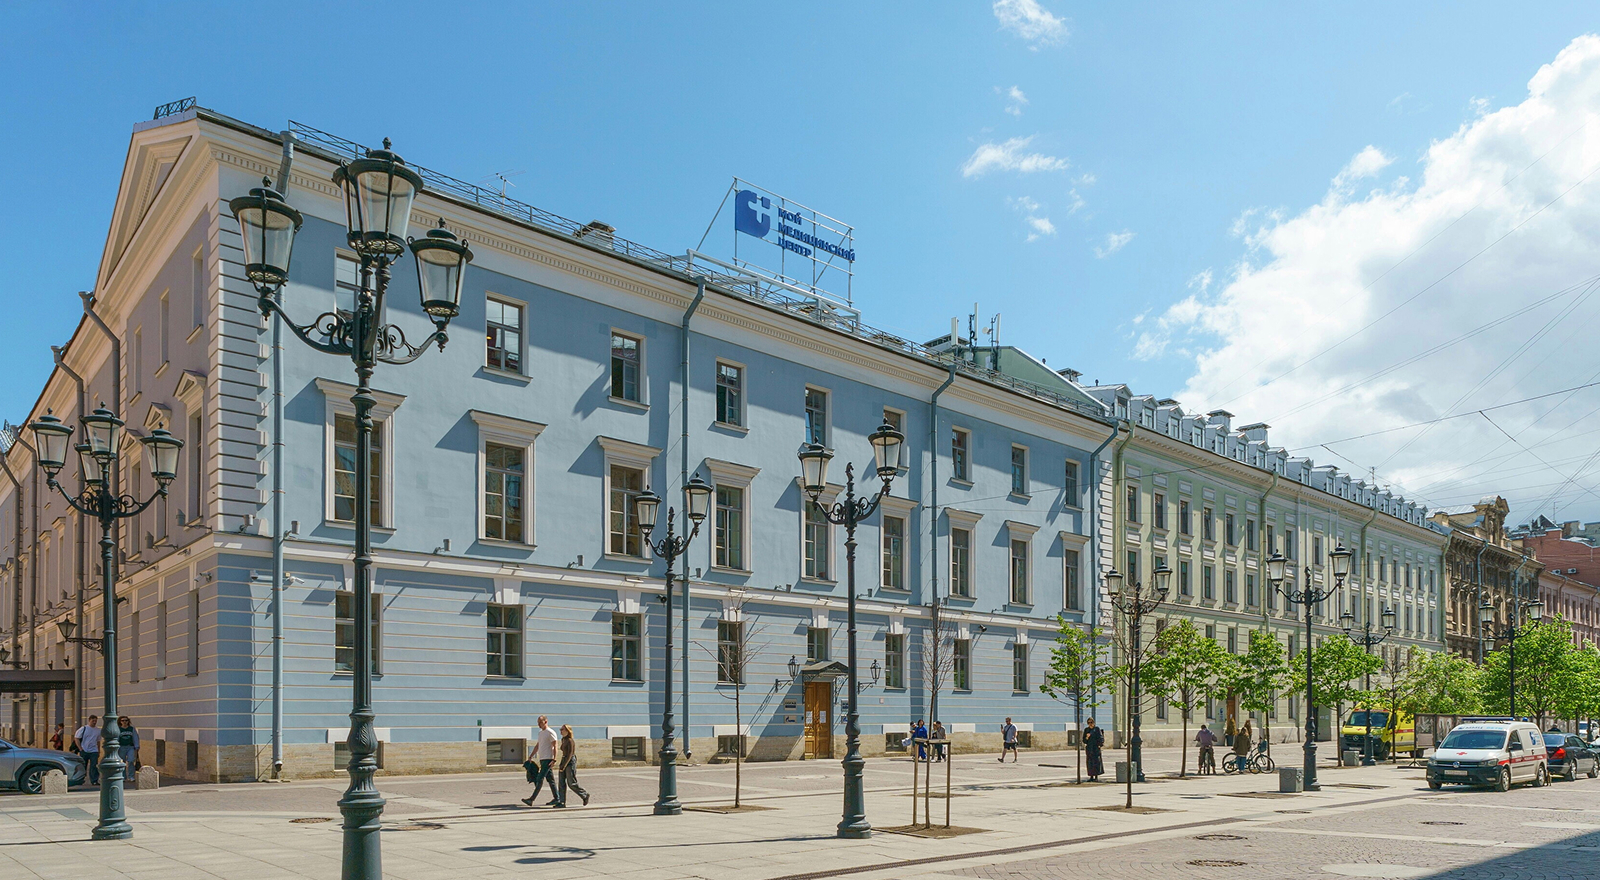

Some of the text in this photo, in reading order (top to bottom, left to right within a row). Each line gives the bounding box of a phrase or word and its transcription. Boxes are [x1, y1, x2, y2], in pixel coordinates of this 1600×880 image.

[778, 208, 802, 225] МОЙ
[778, 222, 855, 261] МЕДИЦИНСКИЙ
[778, 236, 812, 257] ЦЕНТР
